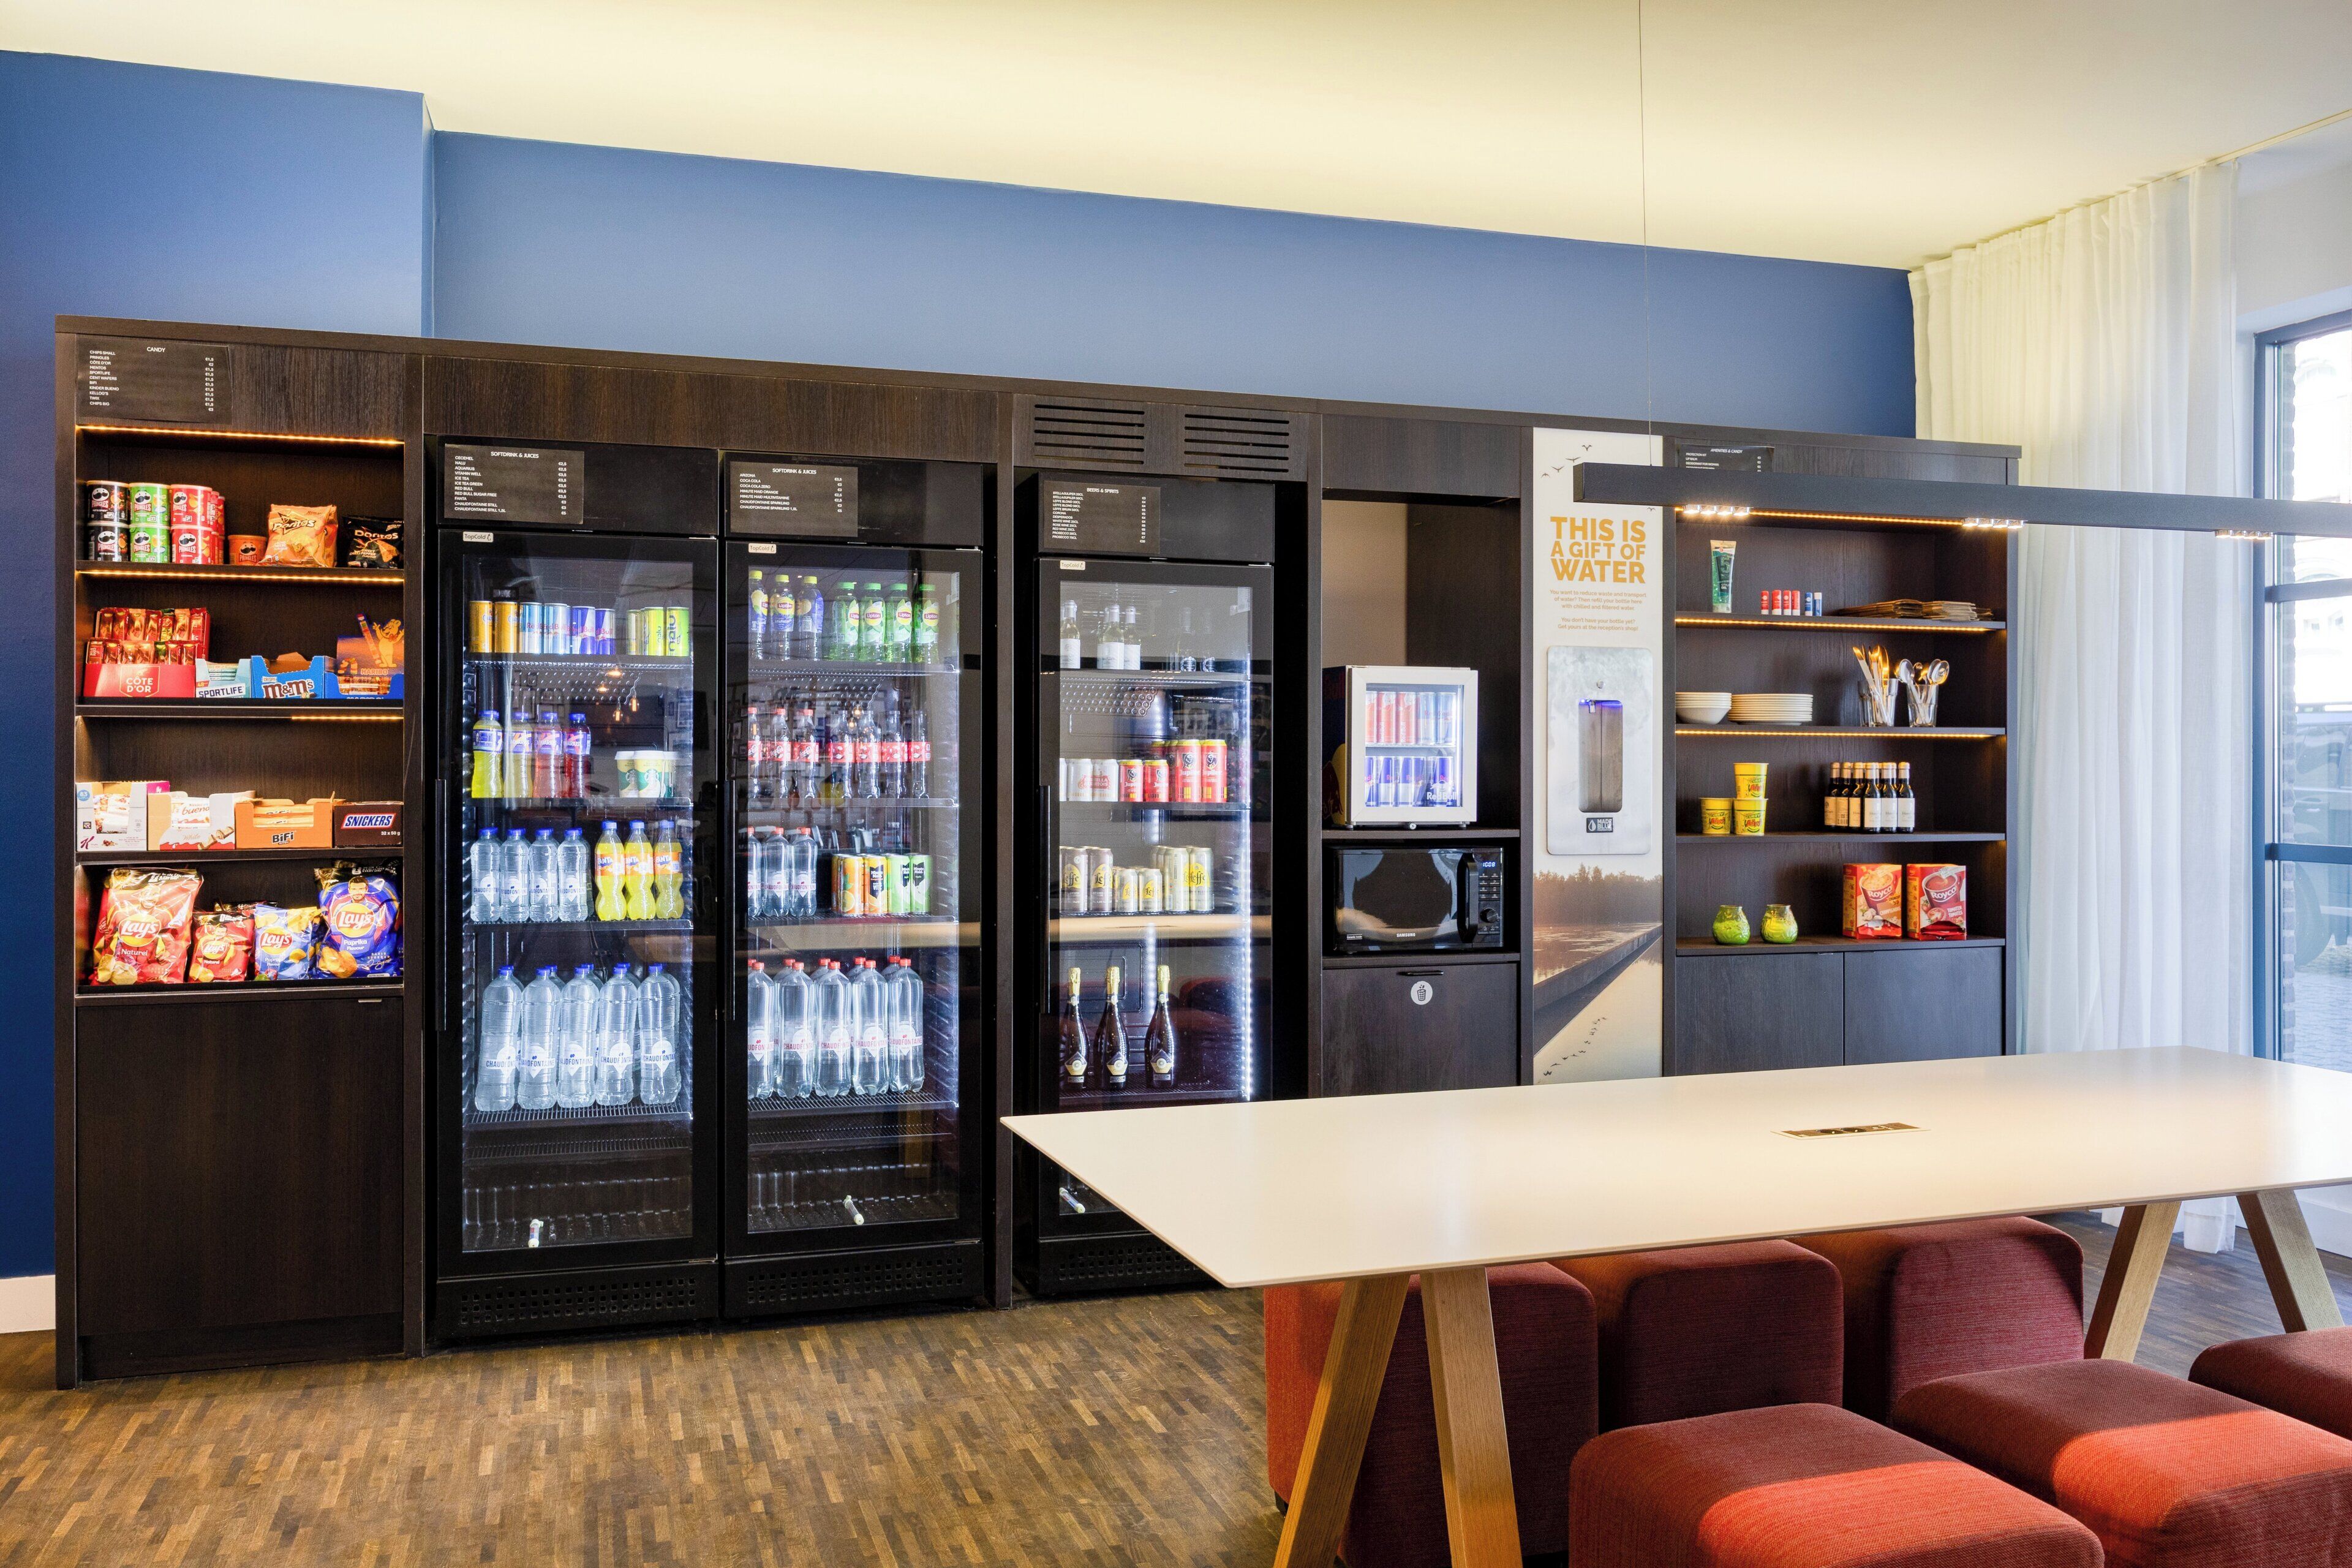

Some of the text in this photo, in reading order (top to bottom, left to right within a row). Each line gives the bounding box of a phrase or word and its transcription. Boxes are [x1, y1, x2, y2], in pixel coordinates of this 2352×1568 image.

[92, 500, 109, 508] PRINGLES
[273, 519, 316, 532] Doritos
[1550, 516, 1646, 543] THIS IS
[355, 530, 399, 540] Doritos
[134, 544, 150, 552] PRINGLES
[1550, 541, 1646, 560] A GIFT OF
[1550, 558, 1646, 584] WATER
[126, 676, 153, 685] CÔTE
[198, 686, 243, 698] SPORTLIFE
[182, 806, 209, 815] bueno
[345, 815, 393, 827] SNICKERS
[272, 832, 294, 843] BiFi
[1869, 886, 1893, 899] Royco
[1931, 887, 1956, 899] Royco
